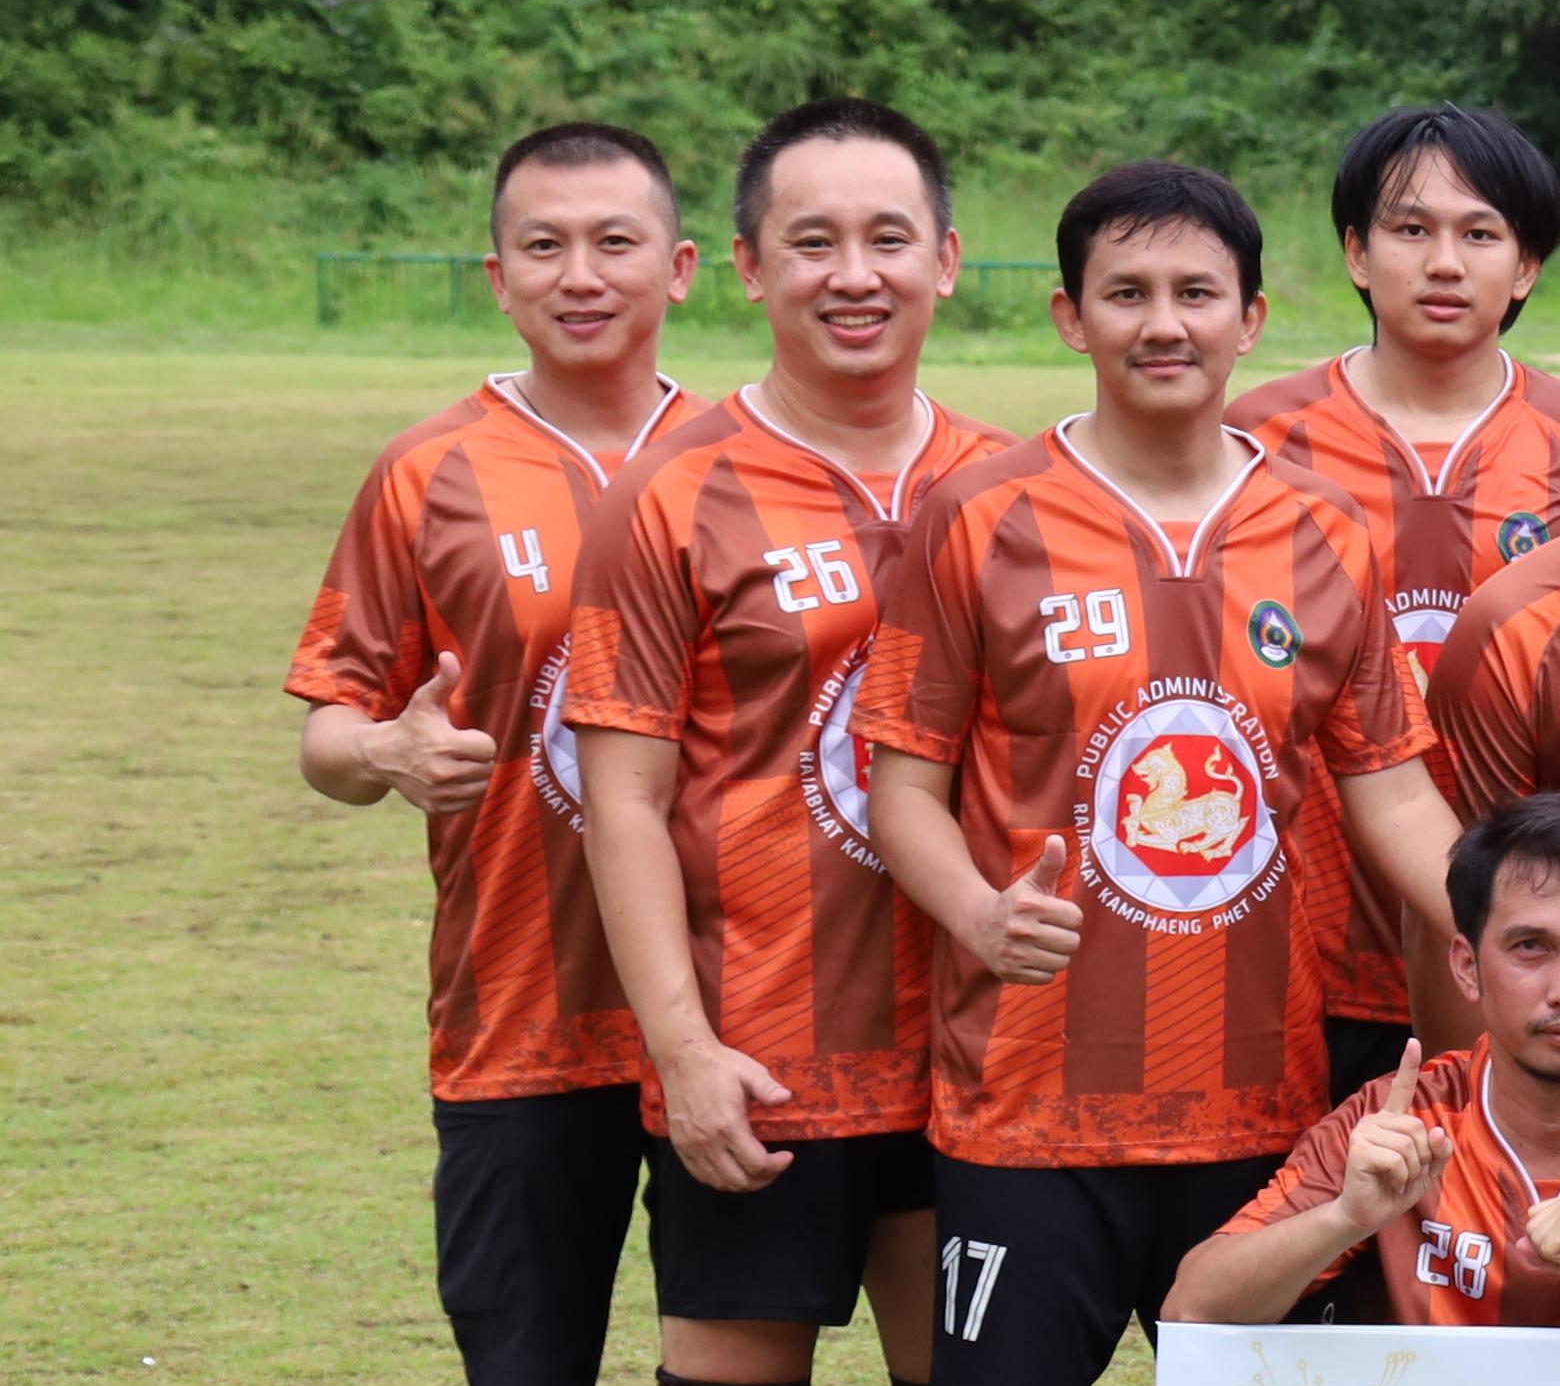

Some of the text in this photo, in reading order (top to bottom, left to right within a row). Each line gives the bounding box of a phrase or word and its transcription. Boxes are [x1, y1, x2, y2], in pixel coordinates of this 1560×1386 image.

[499, 527, 551, 594] 4
[762, 538, 861, 614] 26
[1039, 588, 1131, 664] 29
[1076, 700, 1134, 779] PUBLIC
[1098, 887, 1203, 935] KAMPHAENG
[1212, 899, 1252, 930] PHET
[941, 1235, 1007, 1343] 17
[1416, 1219, 1493, 1300] 28
